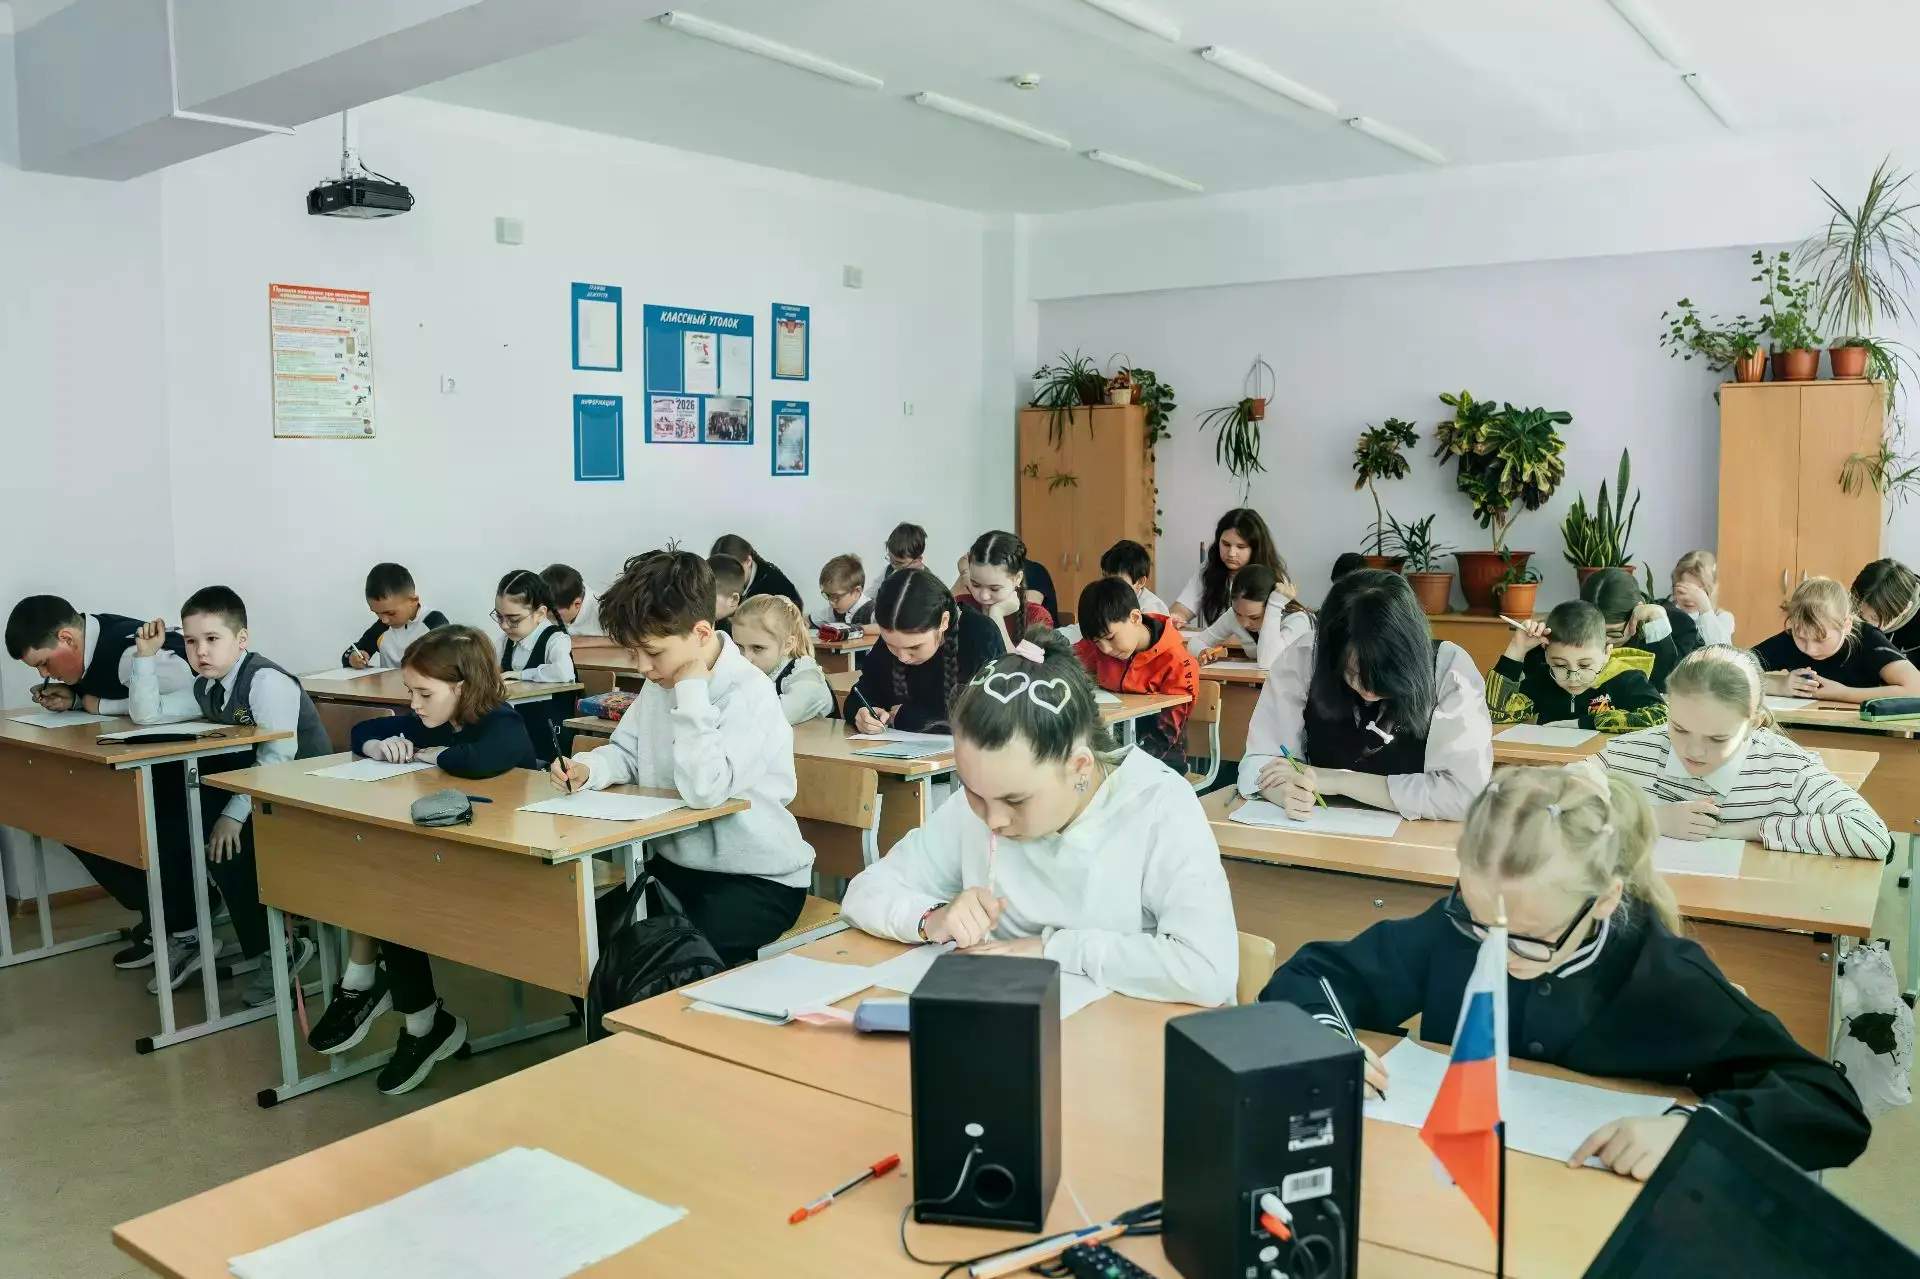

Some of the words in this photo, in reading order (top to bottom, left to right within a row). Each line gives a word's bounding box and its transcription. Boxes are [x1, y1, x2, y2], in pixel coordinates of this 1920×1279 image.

[660, 311, 706, 326] КЛАССНЫЙ
[709, 315, 739, 329] УГОЛОК
[676, 399, 695, 410] 2026
